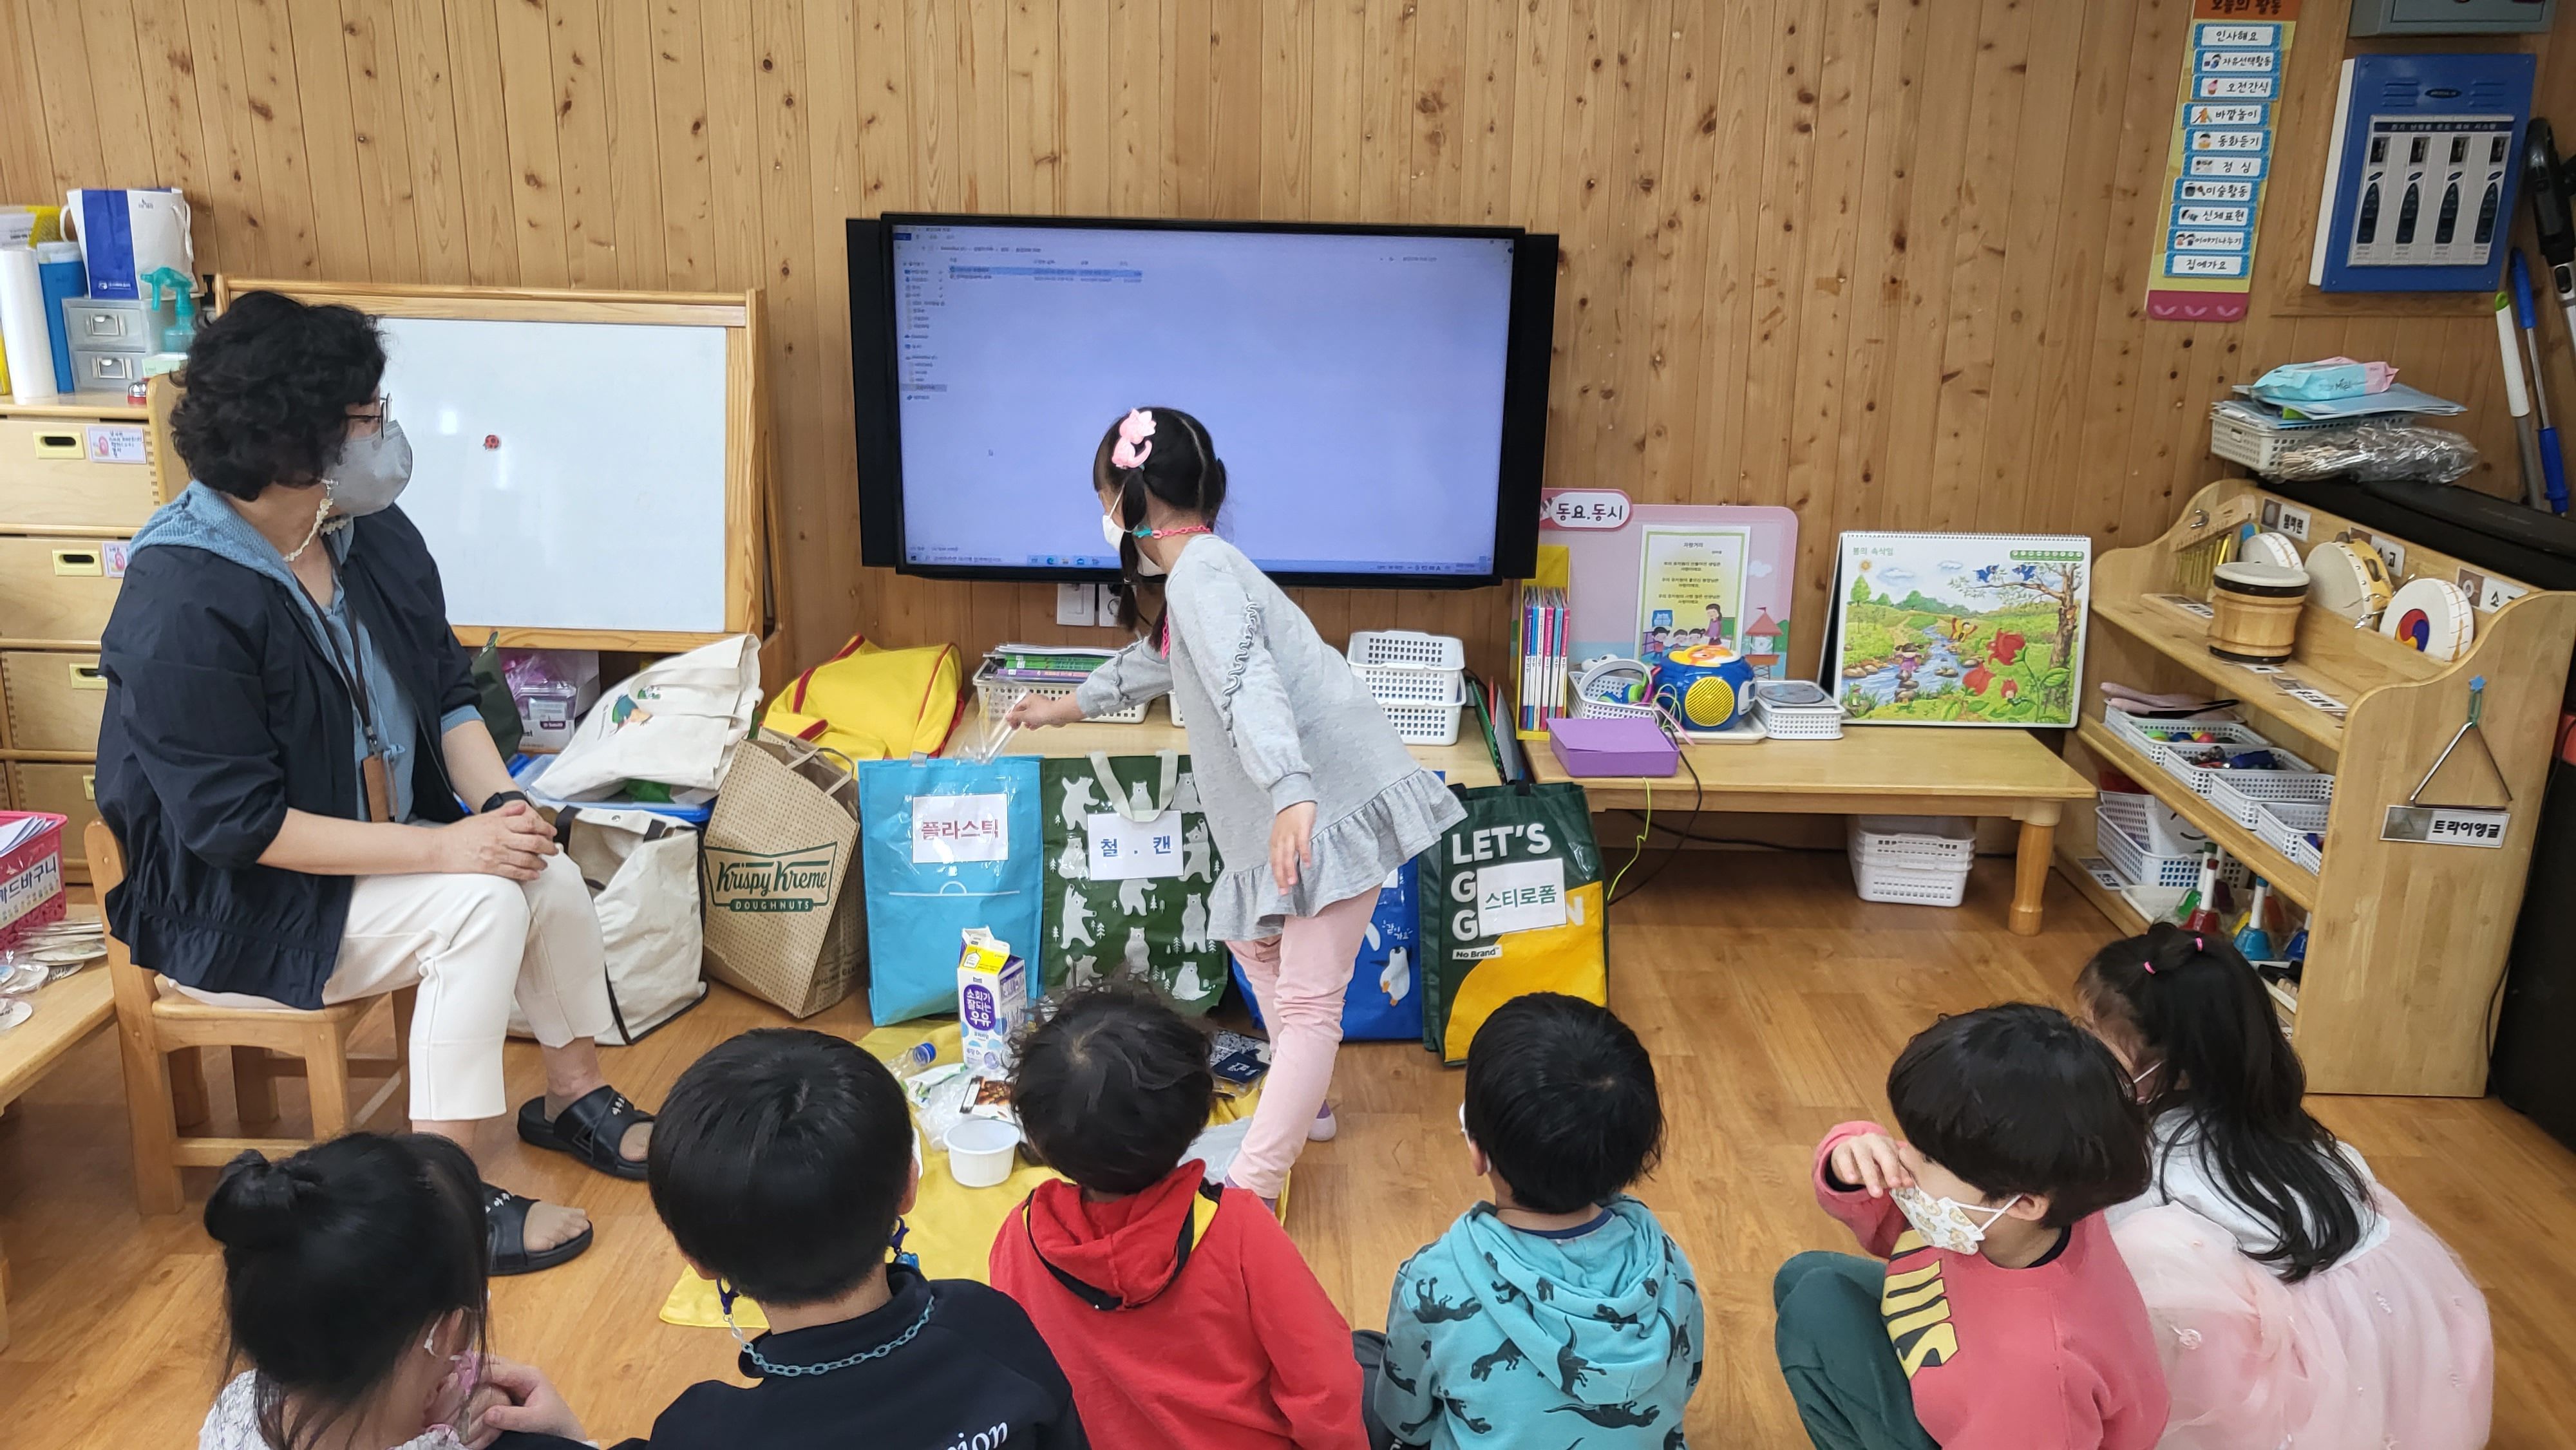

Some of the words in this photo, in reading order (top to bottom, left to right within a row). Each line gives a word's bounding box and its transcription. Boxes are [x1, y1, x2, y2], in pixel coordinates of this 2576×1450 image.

[2215, 30, 2259, 42] 인사해요
[2222, 55, 2272, 67] 자유선택활동
[2226, 81, 2269, 93] 오전간식
[2215, 108, 2257, 121] 바깥놀이
[2218, 135, 2260, 147] 동화듣기
[2206, 184, 2248, 198] 미술활동
[2202, 209, 2245, 222] 신체표현
[2194, 236, 2242, 246] 이야기나누기
[2186, 259, 2228, 270] 집에가요
[921, 818, 999, 841] 플라스틱
[2432, 820, 2501, 838] 트라이앵글
[1100, 838, 1119, 857] 철
[1153, 835, 1171, 855] 캔
[1452, 822, 1551, 865] LET'S
[716, 860, 774, 897] Krispy
[773, 860, 831, 892] Kreme
[1484, 883, 1558, 912] 스티로폼
[735, 899, 810, 910] DOUGHNUTS
[971, 1010, 992, 1027] 우유
